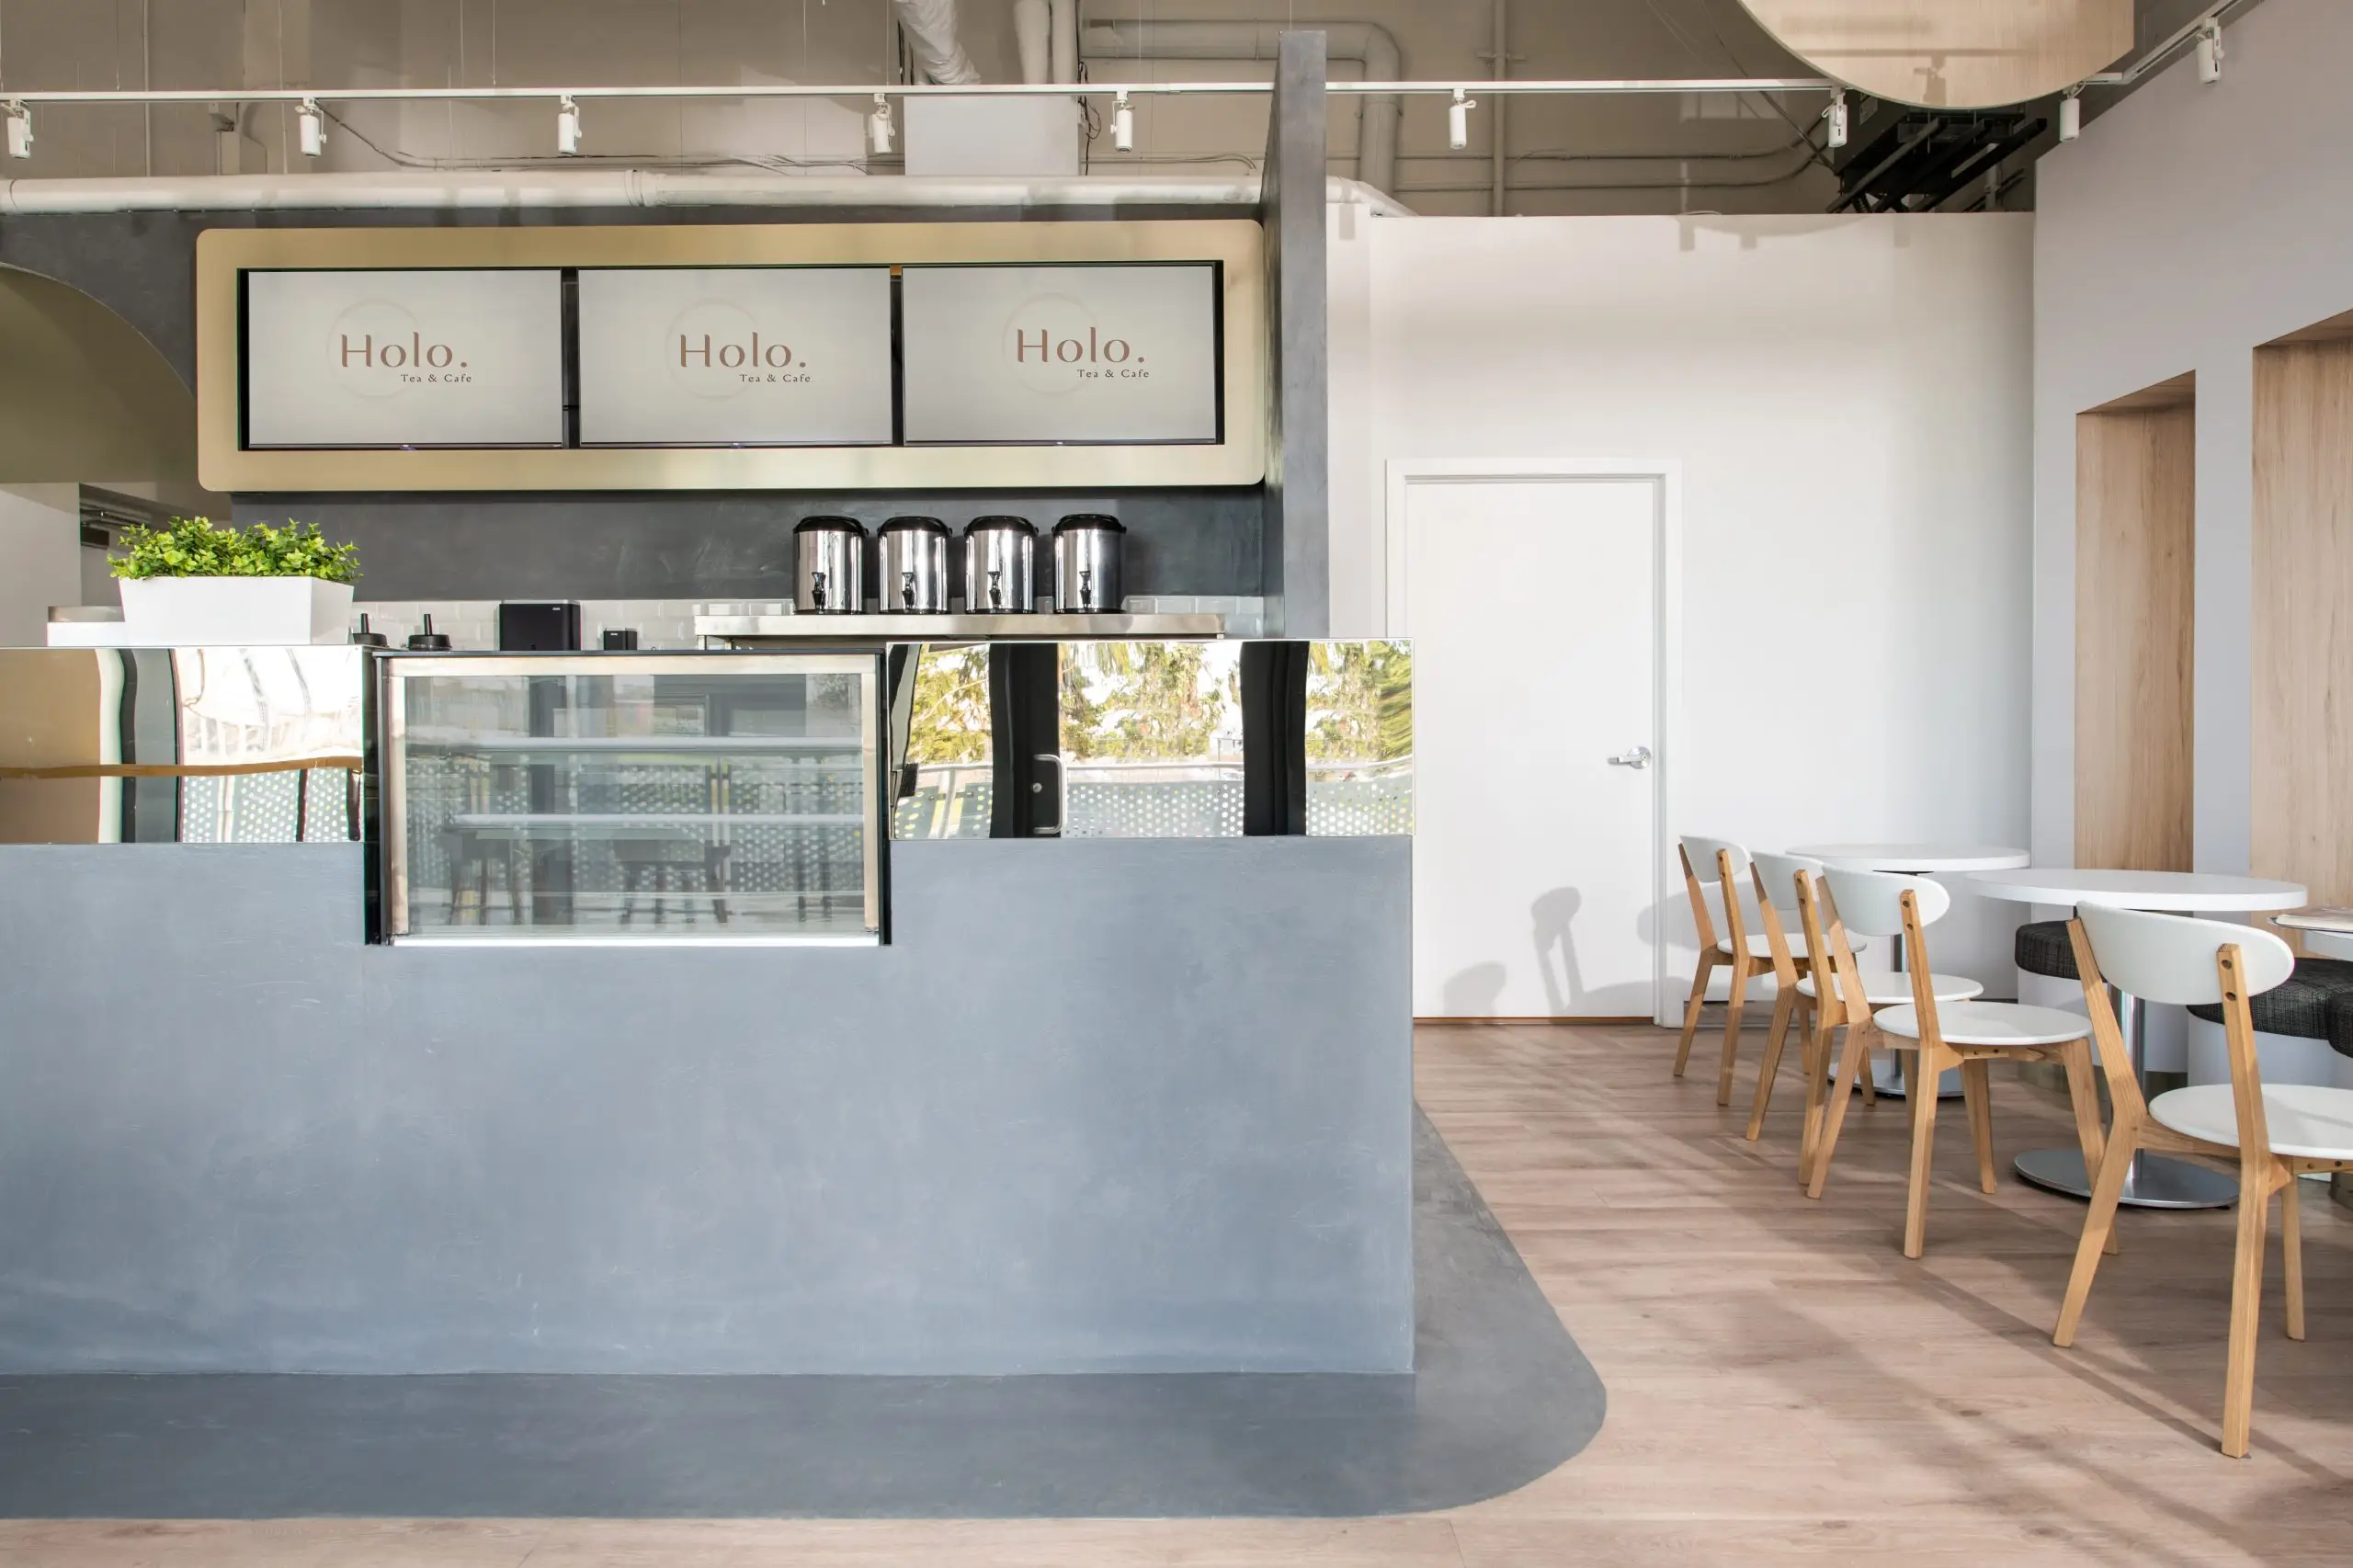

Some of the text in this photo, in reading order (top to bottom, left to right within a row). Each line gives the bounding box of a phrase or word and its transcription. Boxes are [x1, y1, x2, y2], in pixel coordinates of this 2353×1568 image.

[341, 331, 468, 369] Holo.
[680, 331, 807, 369] Holo.
[1017, 326, 1145, 363] Holo.
[401, 373, 472, 382] Tea & Cafe
[739, 373, 811, 382] Tea & Cafe
[1076, 369, 1150, 378] Tea & Cafe
